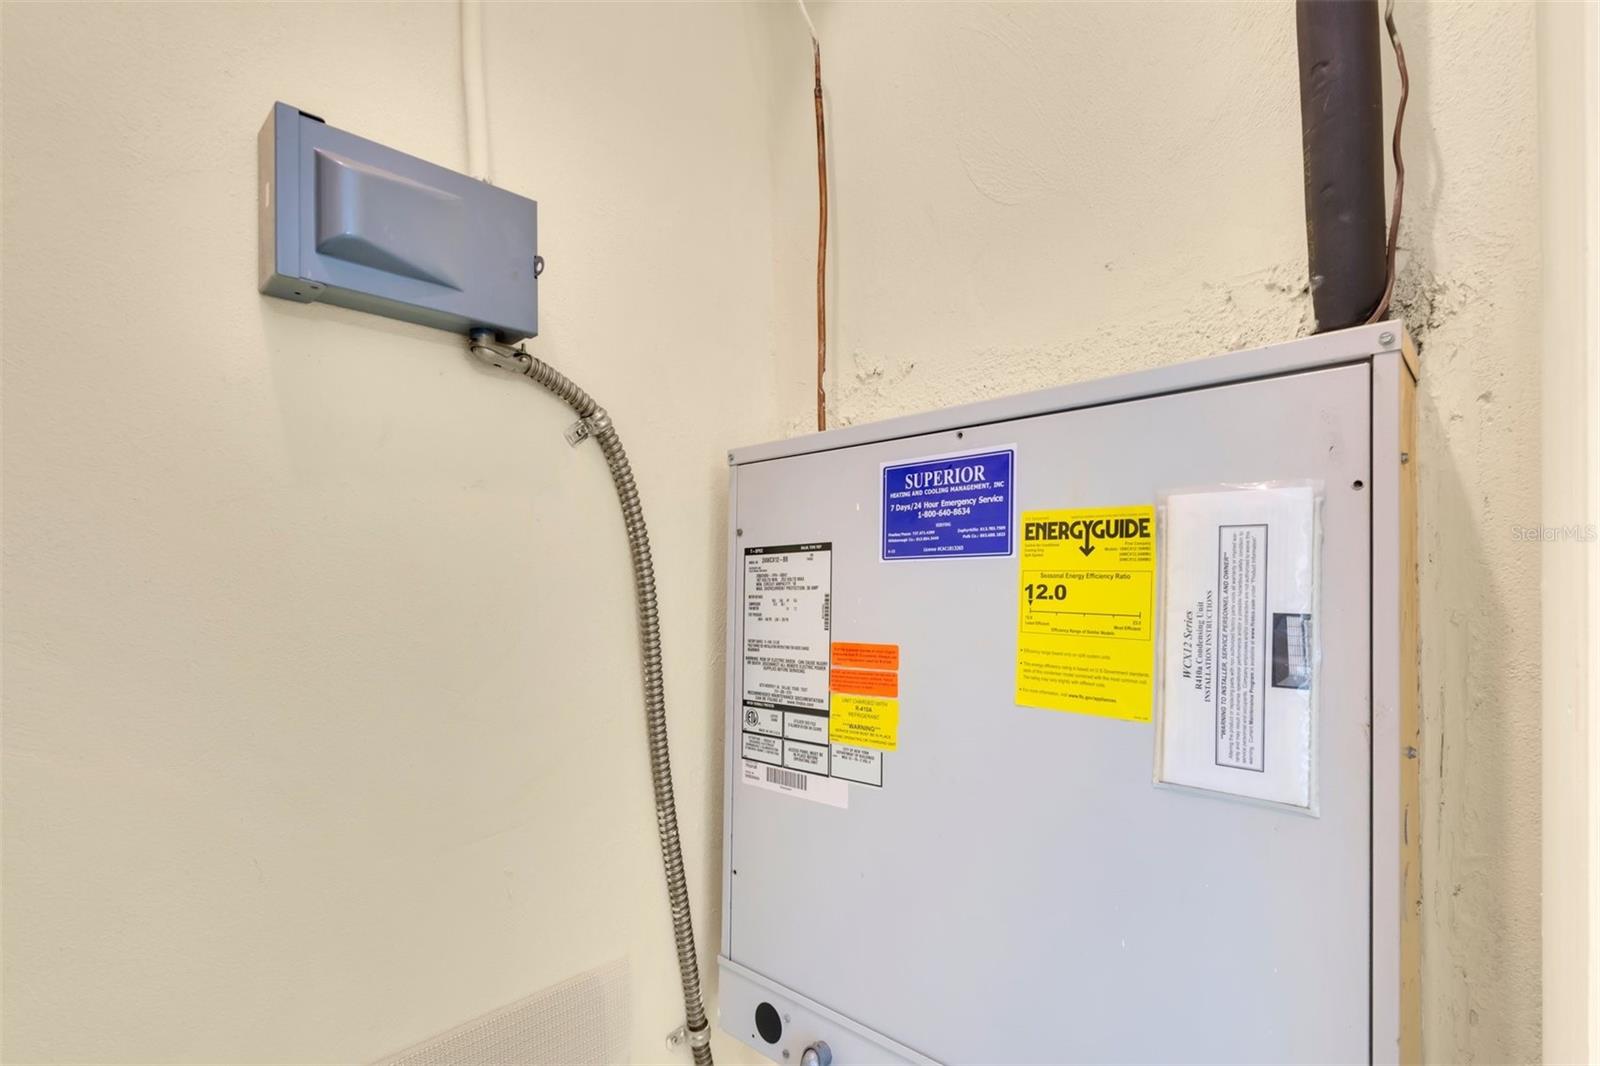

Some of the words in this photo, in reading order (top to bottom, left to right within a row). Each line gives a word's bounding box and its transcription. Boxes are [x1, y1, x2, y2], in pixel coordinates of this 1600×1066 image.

[905, 465, 986, 489] SUPERIOR
[924, 487, 949, 495] COOLING
[950, 482, 991, 492] MANAGEMENT,
[896, 502, 922, 512] Days/24
[941, 498, 977, 507] Emergency
[978, 495, 1004, 504] Service
[918, 507, 970, 518] 1-800-640-8634
[1025, 518, 1150, 540] ENERGYGUIDE
[1025, 584, 1067, 600] 12.0
[1184, 610, 1193, 640] Series
[1196, 620, 1205, 664] Condensing
[1182, 642, 1193, 678] WCX12
[1221, 697, 1227, 705] TO
